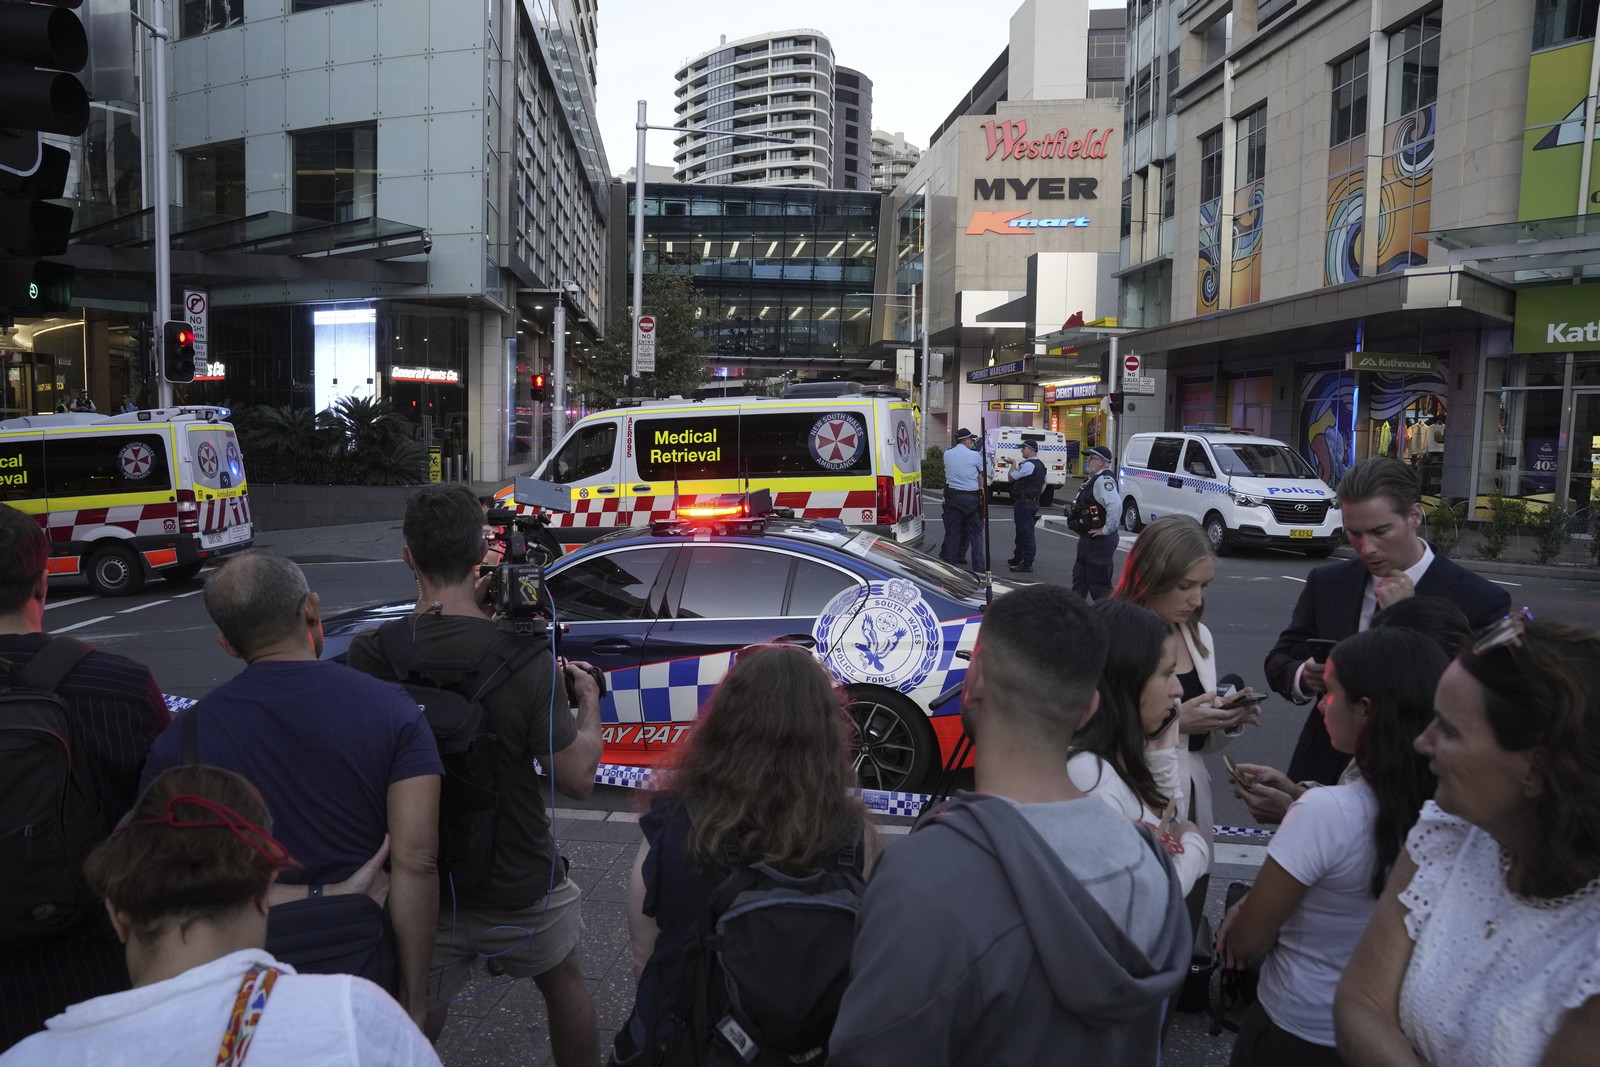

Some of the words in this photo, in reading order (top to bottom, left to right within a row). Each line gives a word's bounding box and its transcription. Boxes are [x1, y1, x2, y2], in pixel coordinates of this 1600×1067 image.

[980, 119, 1114, 161] Westfield
[974, 177, 1099, 201] MYER
[189, 315, 202, 324] NO
[1378, 358, 1431, 368] Kathmandu
[392, 366, 425, 379] General
[424, 368, 447, 380] Pants
[446, 370, 459, 381] Co.
[970, 368, 989, 380] CHEMIST
[989, 363, 1016, 377] WAREHOUSE
[1055, 386, 1073, 399] CHEMIST
[810, 420, 823, 437] NEW
[822, 412, 846, 423] SOUTH
[846, 414, 864, 437] WALES
[654, 428, 717, 445] Medical
[650, 447, 721, 463] Retrieval
[815, 456, 858, 470] AMBULANCE
[216, 489, 237, 498] Ambulance
[1266, 487, 1326, 496] Police
[848, 603, 866, 617] NEW
[874, 600, 904, 614] SOUTH
[907, 616, 922, 645] WALES
[834, 647, 857, 676] POLICE
[865, 673, 897, 683] FORCE
[601, 726, 634, 744] AY
[632, 725, 692, 744] PAT
[603, 769, 644, 780] POLICE
[905, 800, 923, 809] PO
